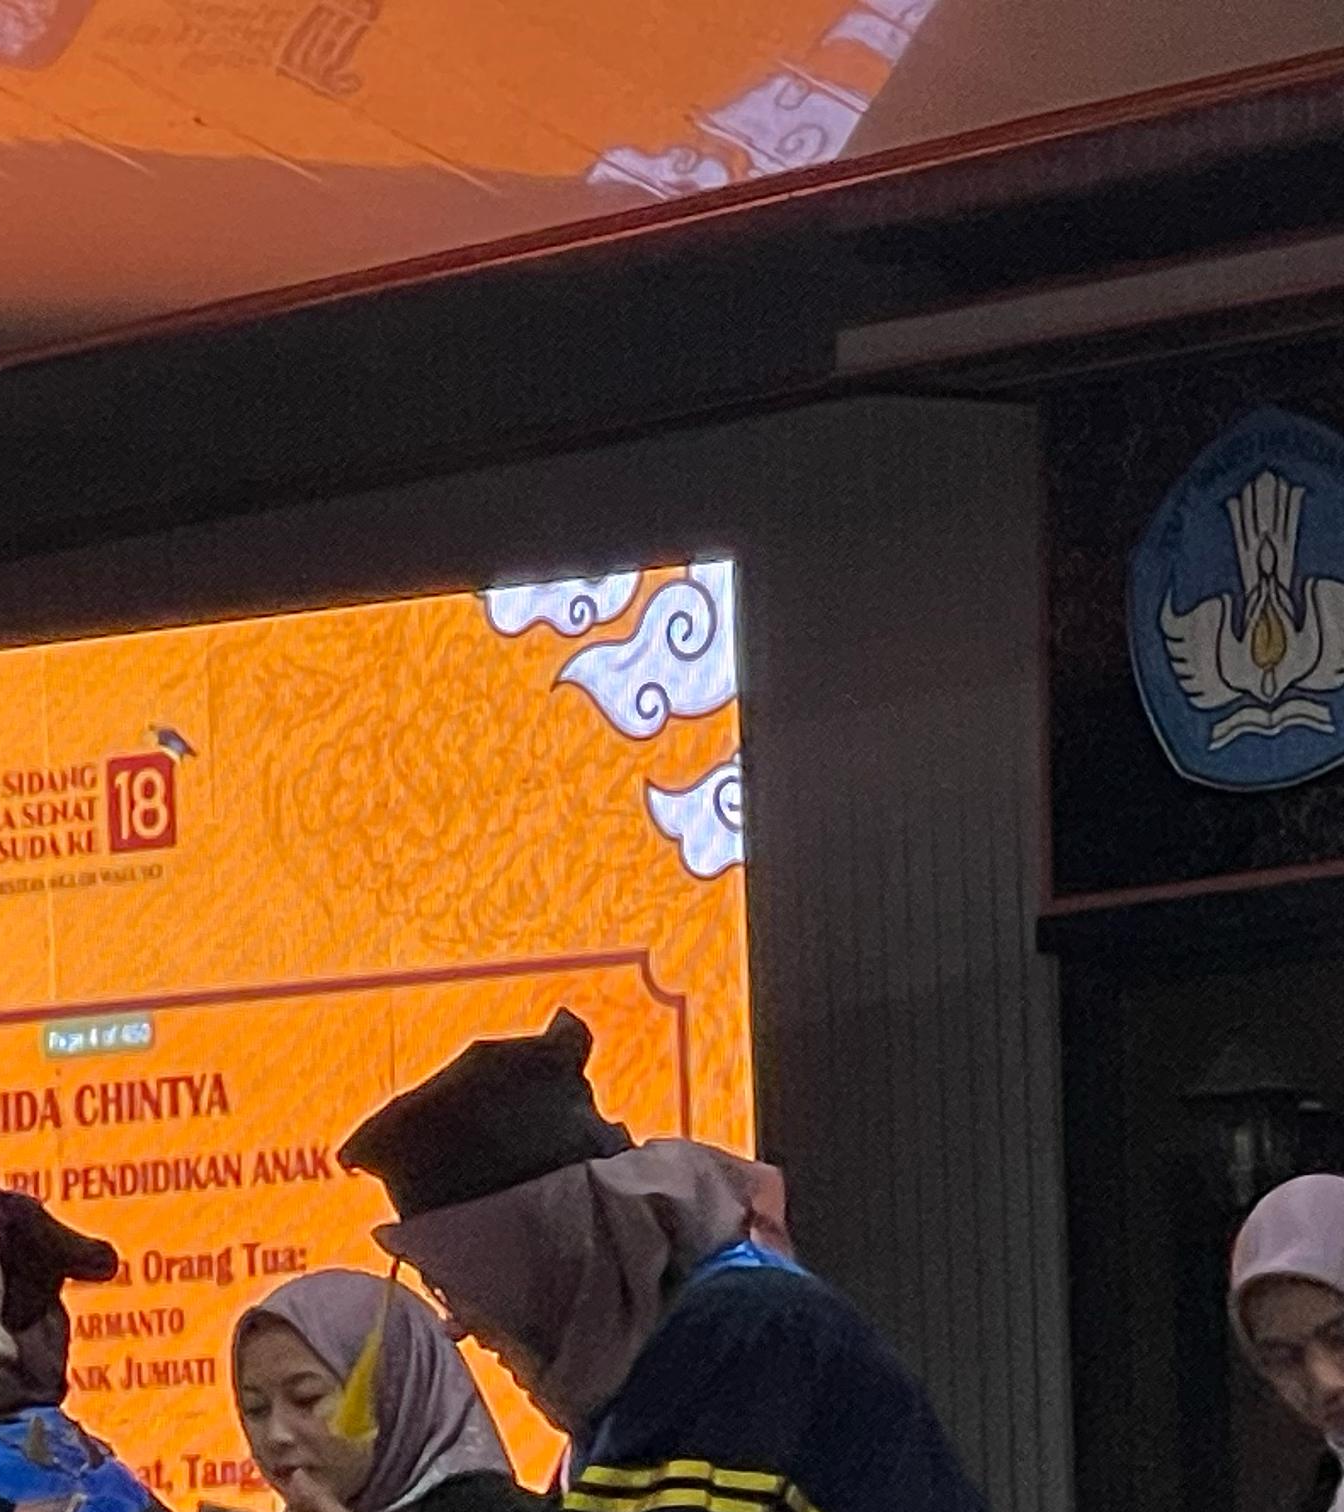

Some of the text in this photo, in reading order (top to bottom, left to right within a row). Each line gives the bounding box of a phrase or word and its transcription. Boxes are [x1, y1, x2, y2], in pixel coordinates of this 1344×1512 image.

[2, 764, 98, 797] SIDANG
[115, 767, 168, 840] 18
[74, 1073, 229, 1127] CHINTYA
[62, 1153, 242, 1200] PENDIDIKAN
[252, 1146, 332, 1186] ANAK
[144, 1246, 233, 1287] Orang
